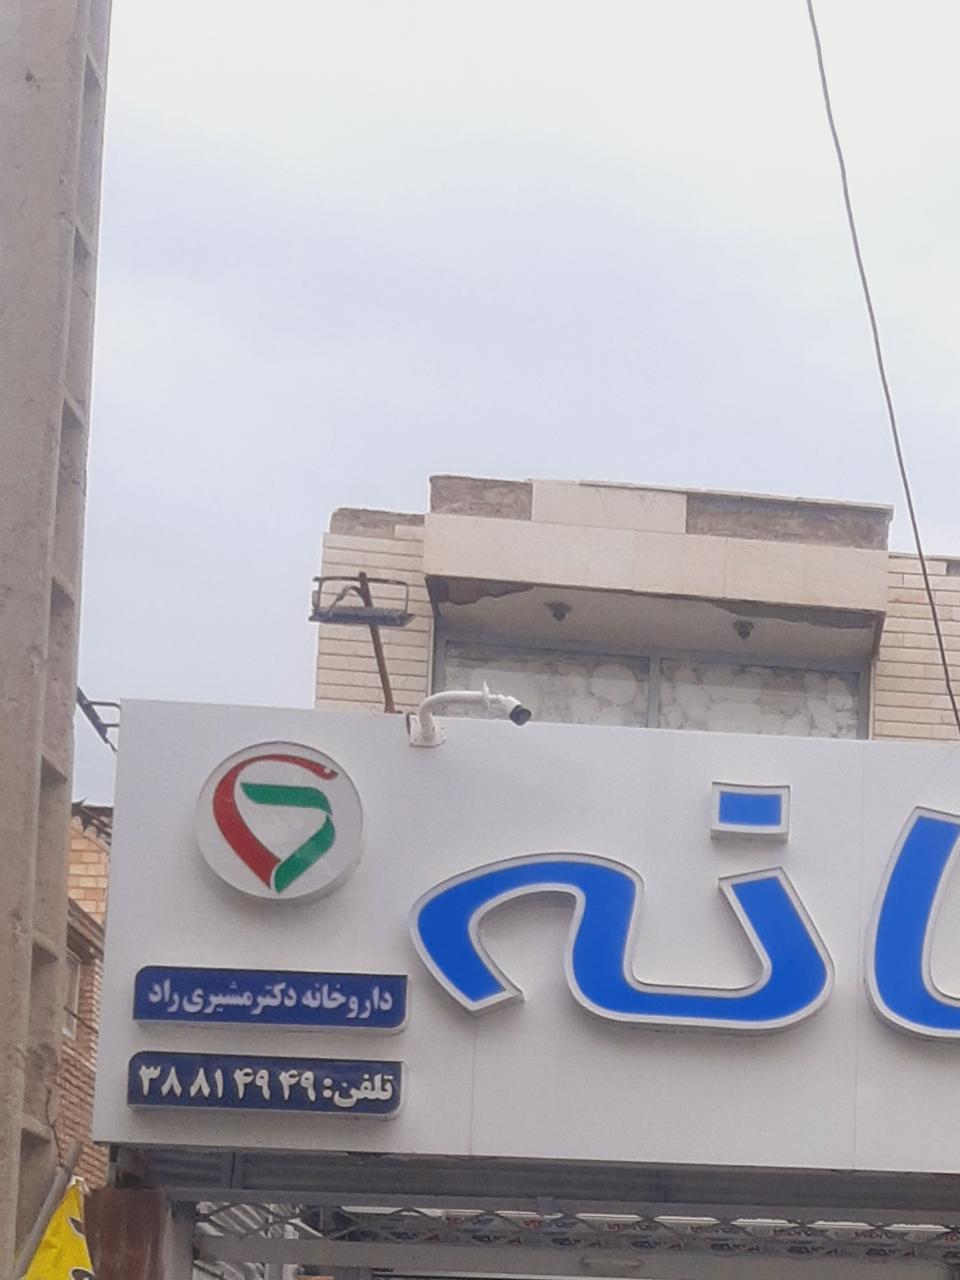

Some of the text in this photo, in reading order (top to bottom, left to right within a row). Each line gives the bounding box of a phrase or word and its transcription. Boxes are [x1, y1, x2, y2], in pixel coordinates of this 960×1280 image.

[250, 982, 297, 1015] دکتر
[302, 983, 393, 1019] داروخانه
[323, 1073, 394, 1107] تلفن:
